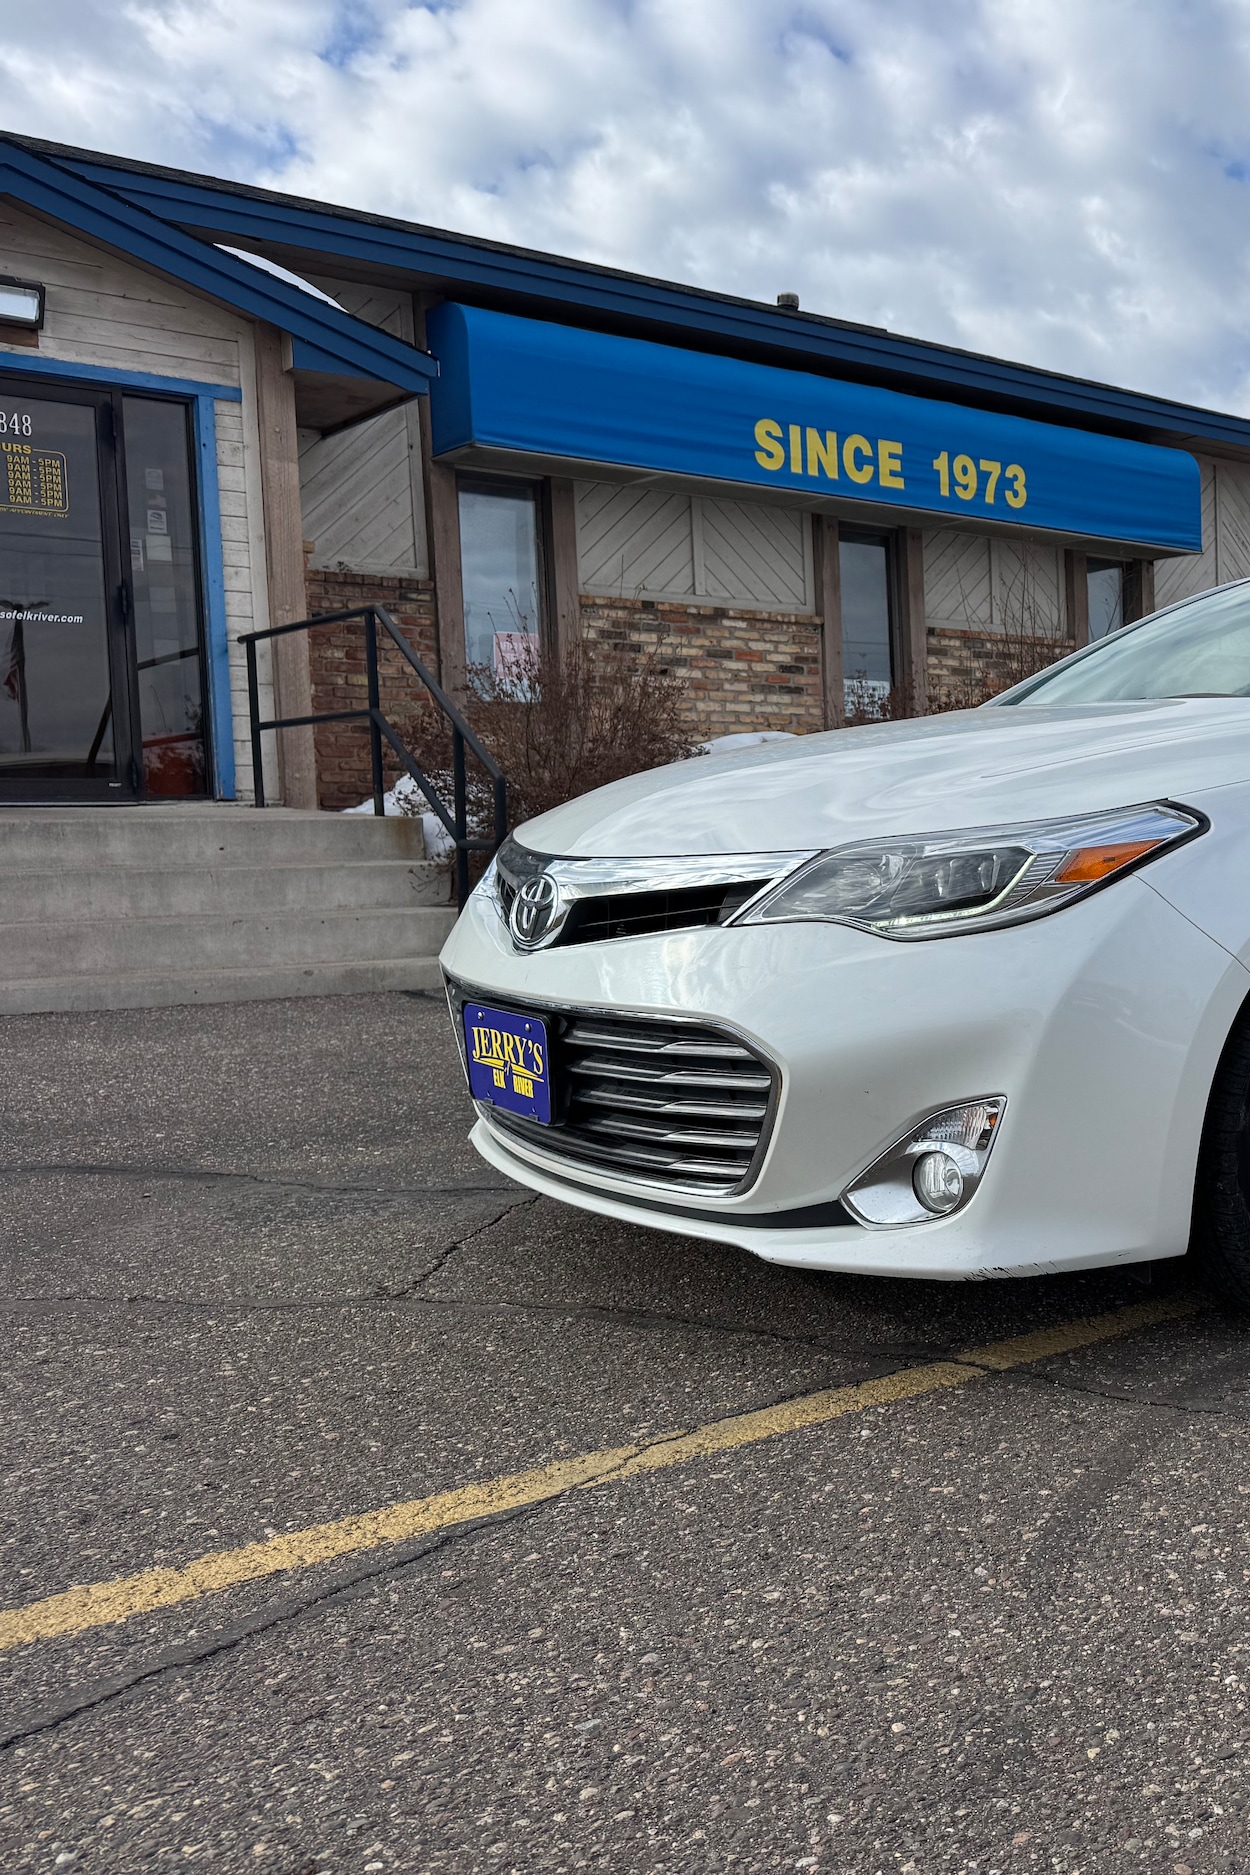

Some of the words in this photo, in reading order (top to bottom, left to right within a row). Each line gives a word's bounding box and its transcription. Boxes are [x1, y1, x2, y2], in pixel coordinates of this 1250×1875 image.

[0, 442, 32, 454] URS
[7, 455, 29, 464] 9AM
[38, 458, 60, 468] 5PM
[754, 418, 905, 490] SINCE
[932, 451, 1027, 508] 1973
[8, 463, 30, 472] 9AM
[39, 466, 61, 476] 5PM
[8, 471, 31, 480] 9AM
[39, 474, 61, 484] 5PM
[9, 479, 31, 488] 9AM
[40, 482, 62, 491] 5PM
[9, 487, 32, 496] 9AM
[41, 490, 62, 500] 5PM
[10, 495, 32, 504] 9AM
[41, 498, 62, 507] 5PM
[0, 610, 83, 623] sofelkriver.com
[471, 1027, 544, 1075] JERRY'S
[493, 1068, 506, 1089] ELK
[513, 1075, 534, 1098] RIVER
